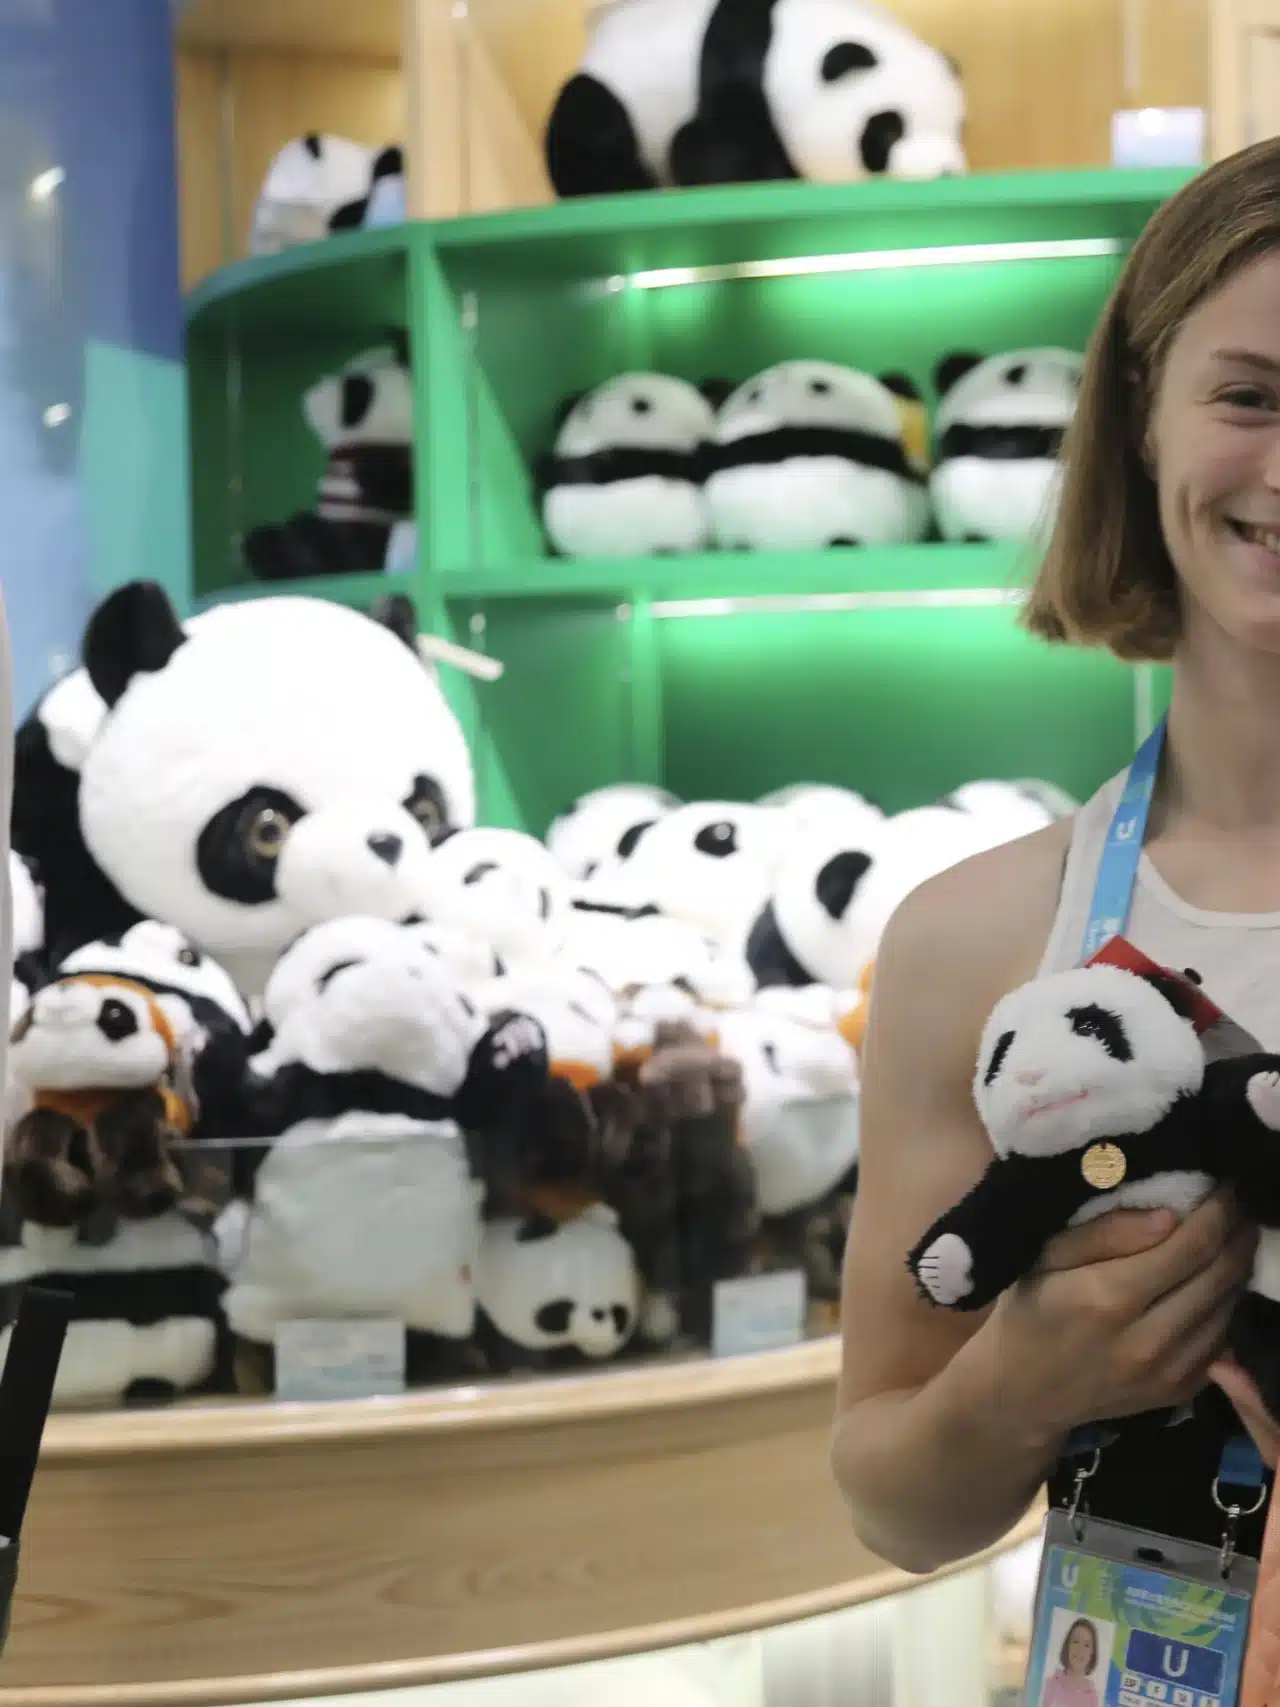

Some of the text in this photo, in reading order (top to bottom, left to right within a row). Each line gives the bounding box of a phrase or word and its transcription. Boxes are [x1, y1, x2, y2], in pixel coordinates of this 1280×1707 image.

[1116, 816, 1137, 840] U
[1062, 1564, 1079, 1588] U
[1162, 1645, 1190, 1677] U
